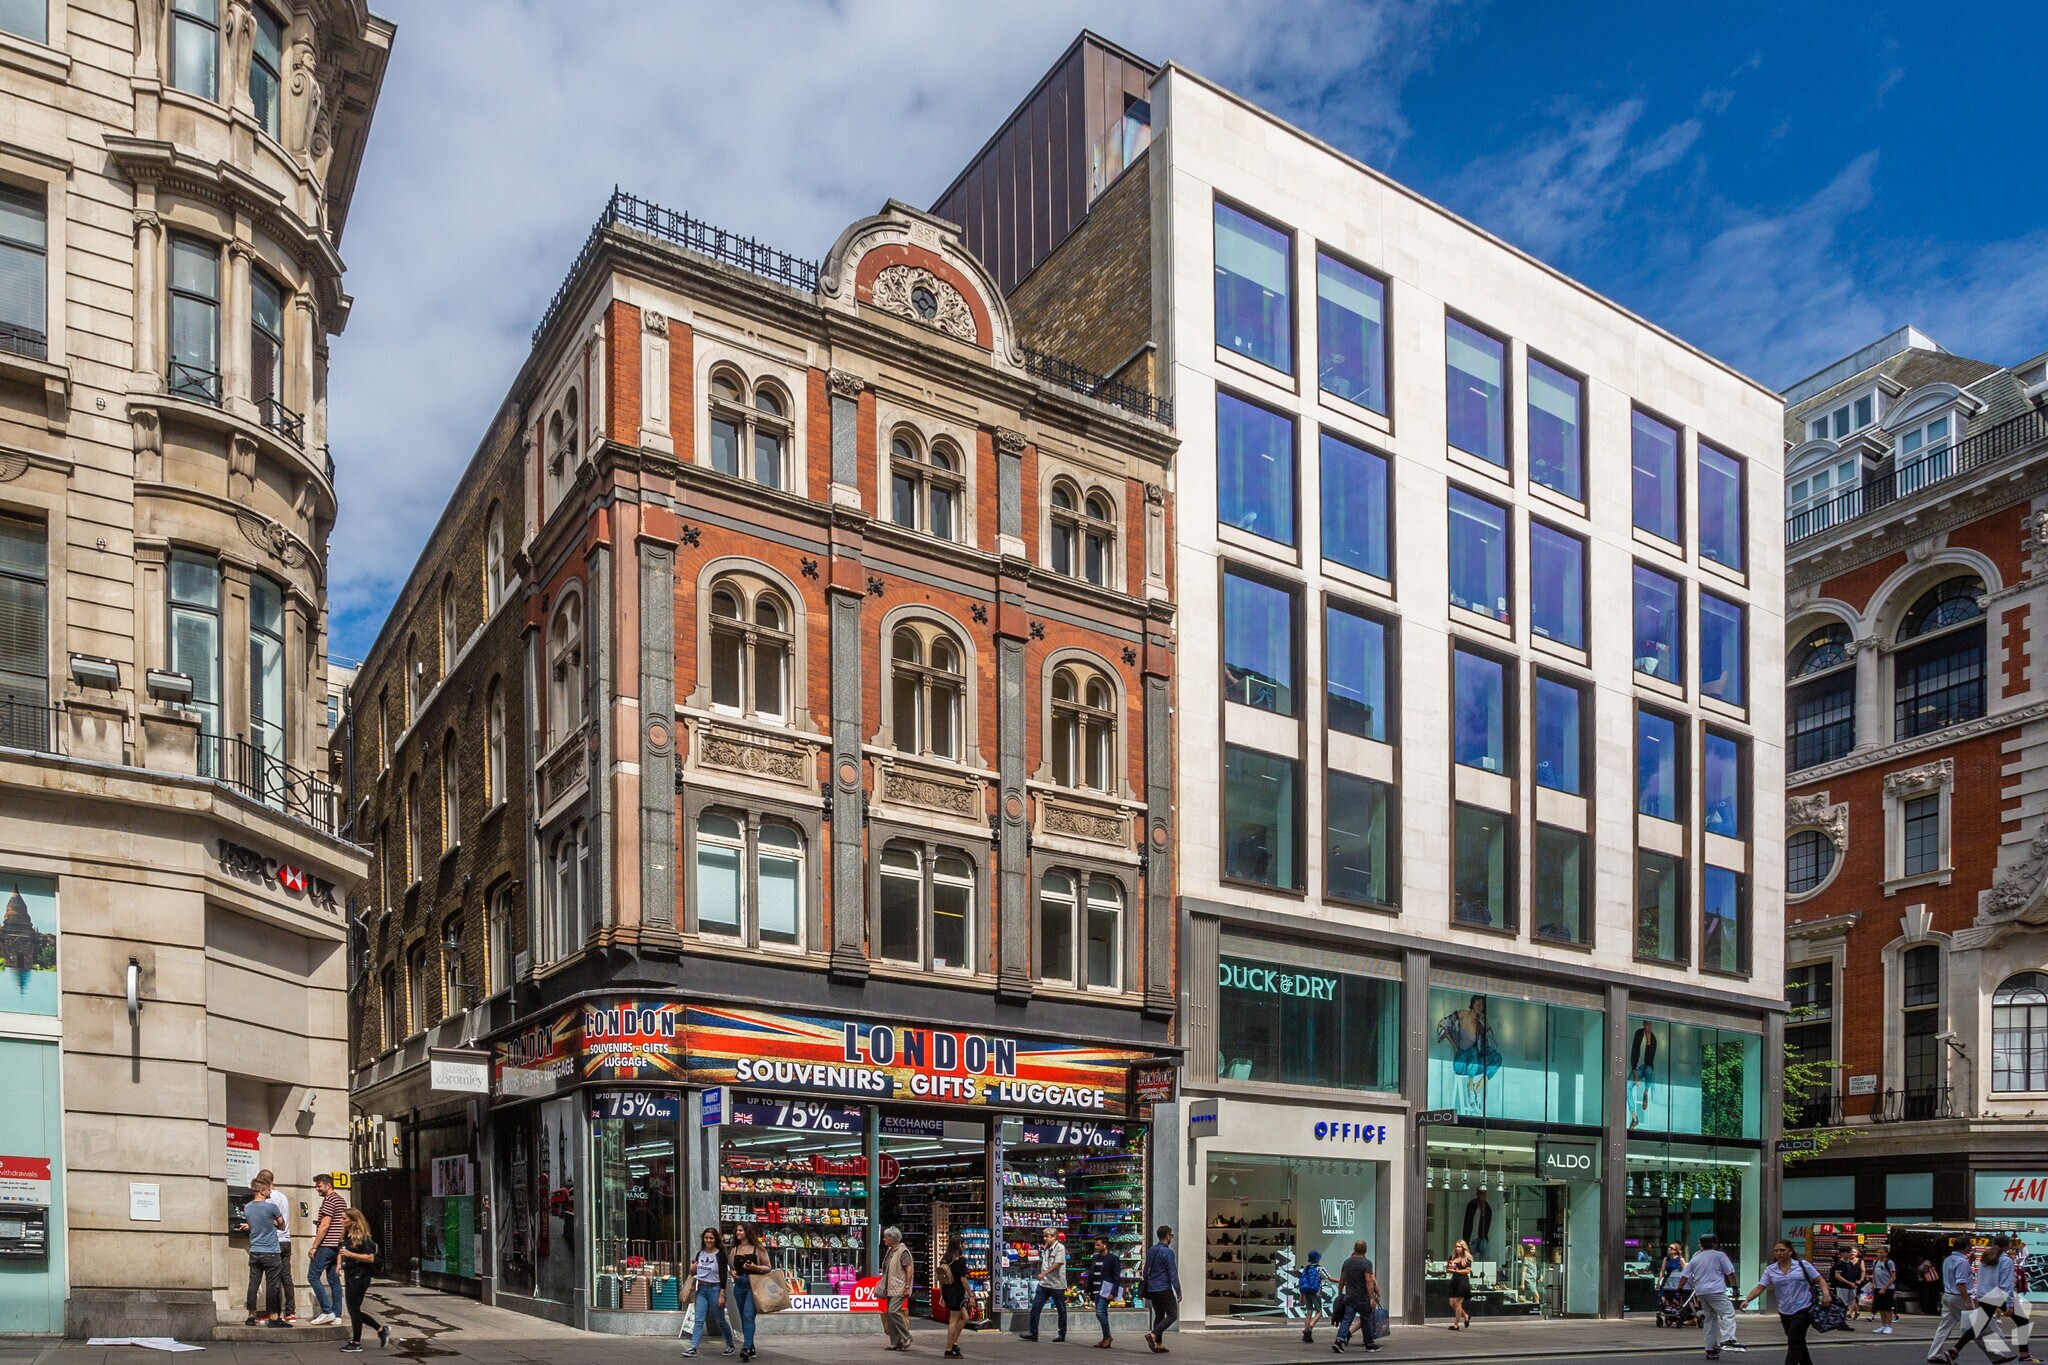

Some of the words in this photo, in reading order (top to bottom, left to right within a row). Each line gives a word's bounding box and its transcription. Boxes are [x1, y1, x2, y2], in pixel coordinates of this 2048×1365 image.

[305, 873, 338, 906] UK
[1219, 963, 1279, 993] DUCK
[1295, 974, 1338, 1001] DRY
[585, 1009, 676, 1038] LONDON
[507, 1024, 554, 1069] LONDON
[589, 1042, 633, 1054] SOUVENIRS
[642, 1042, 669, 1054] GIFTS
[844, 1021, 1017, 1077] LONDON
[441, 1063, 477, 1076] Russell
[544, 1057, 575, 1082] LUGGAGE
[604, 1056, 648, 1068] LUGGAGE
[736, 1058, 886, 1092] SOUVENIRS
[911, 1073, 977, 1099] GIFTS
[1000, 1081, 1105, 1109] LUGGAGE
[1138, 1070, 1172, 1086] LONDON
[610, 1092, 657, 1117] 75%
[656, 1109, 671, 1117] OFF
[747, 1097, 760, 1105] UP
[774, 1100, 833, 1130] 75%
[833, 1122, 850, 1130] OFF
[885, 1117, 943, 1130] EXCHANGE
[1191, 1114, 1217, 1123] OFFICE
[1418, 1112, 1452, 1124] ALDO
[879, 1126, 925, 1135] OMMISSION
[1056, 1120, 1103, 1146] 75%
[1103, 1139, 1116, 1147] OFF
[1315, 1121, 1387, 1142] OFFICE
[994, 1123, 1002, 1187] MONEY
[1777, 1141, 1812, 1149] ALDO
[1547, 1153, 1591, 1170] ALDO
[2003, 1178, 2048, 1202] H&M
[1320, 1198, 1355, 1228] VLTG
[855, 1287, 878, 1301] 0%
